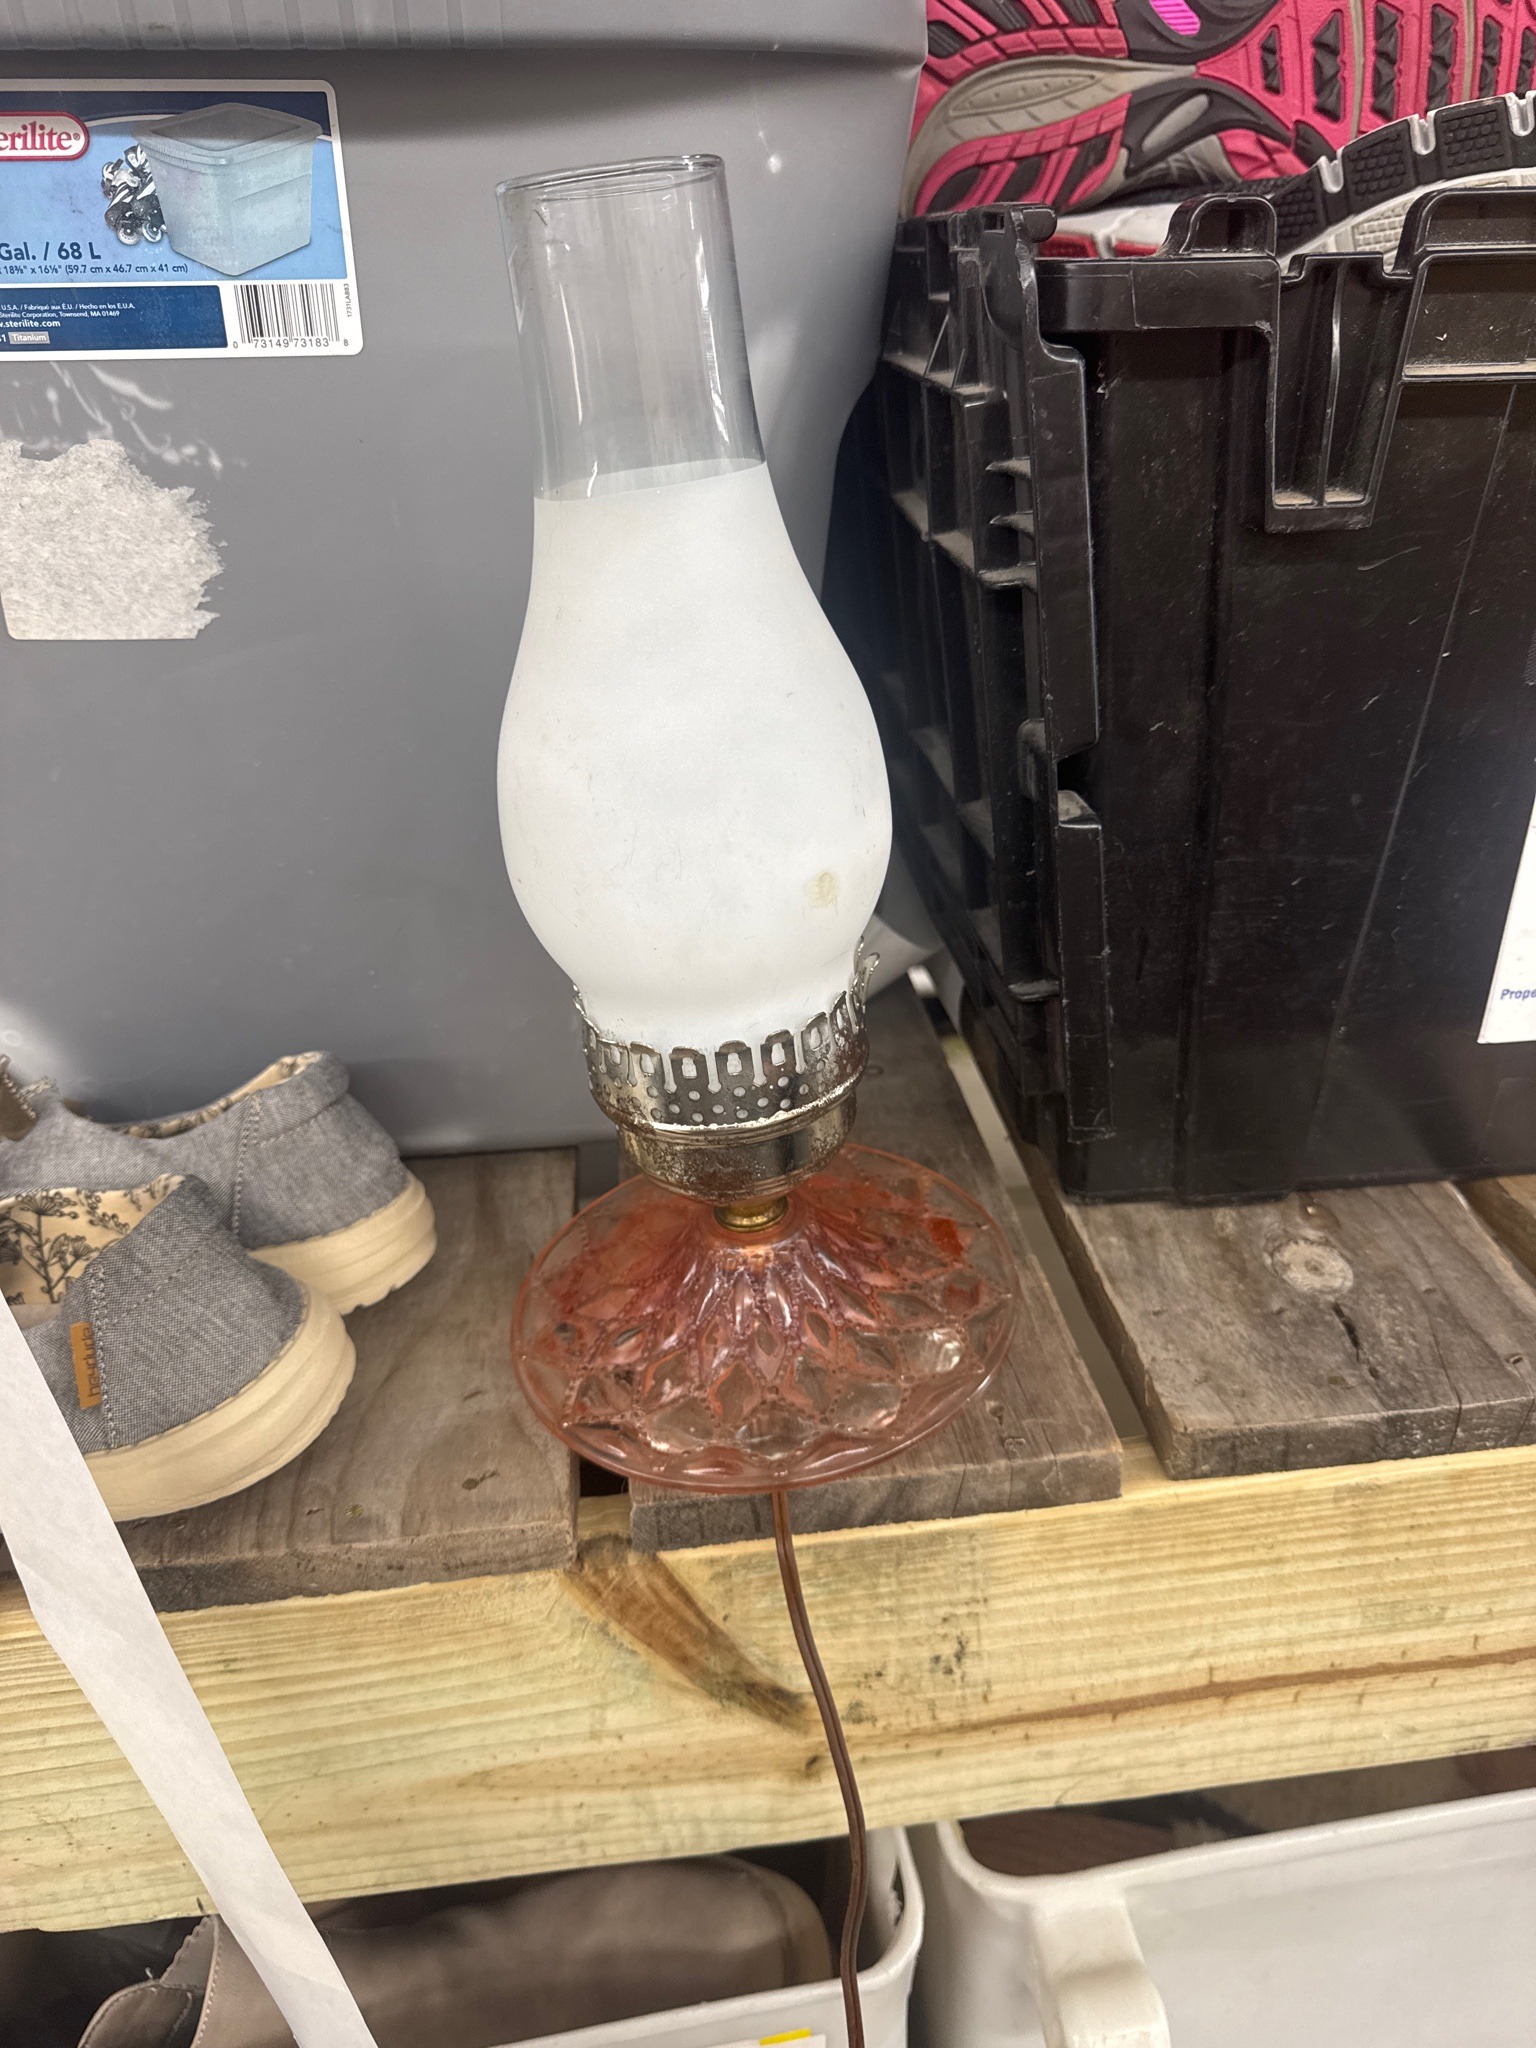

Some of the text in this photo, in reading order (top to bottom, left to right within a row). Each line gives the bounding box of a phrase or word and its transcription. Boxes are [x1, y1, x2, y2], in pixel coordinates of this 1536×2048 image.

[0, 241, 101, 261] Gal. / 68 L
[65, 264, 87, 275] (59.7
[90, 266, 104, 274] cm
[105, 266, 112, 274] x
[112, 264, 132, 274] 46.7
[135, 265, 149, 273] cm
[158, 263, 170, 273] 41
[171, 263, 189, 274] cm)
[12, 333, 48, 342] Titanium
[232, 337, 350, 349] 0 73149 73183 8
